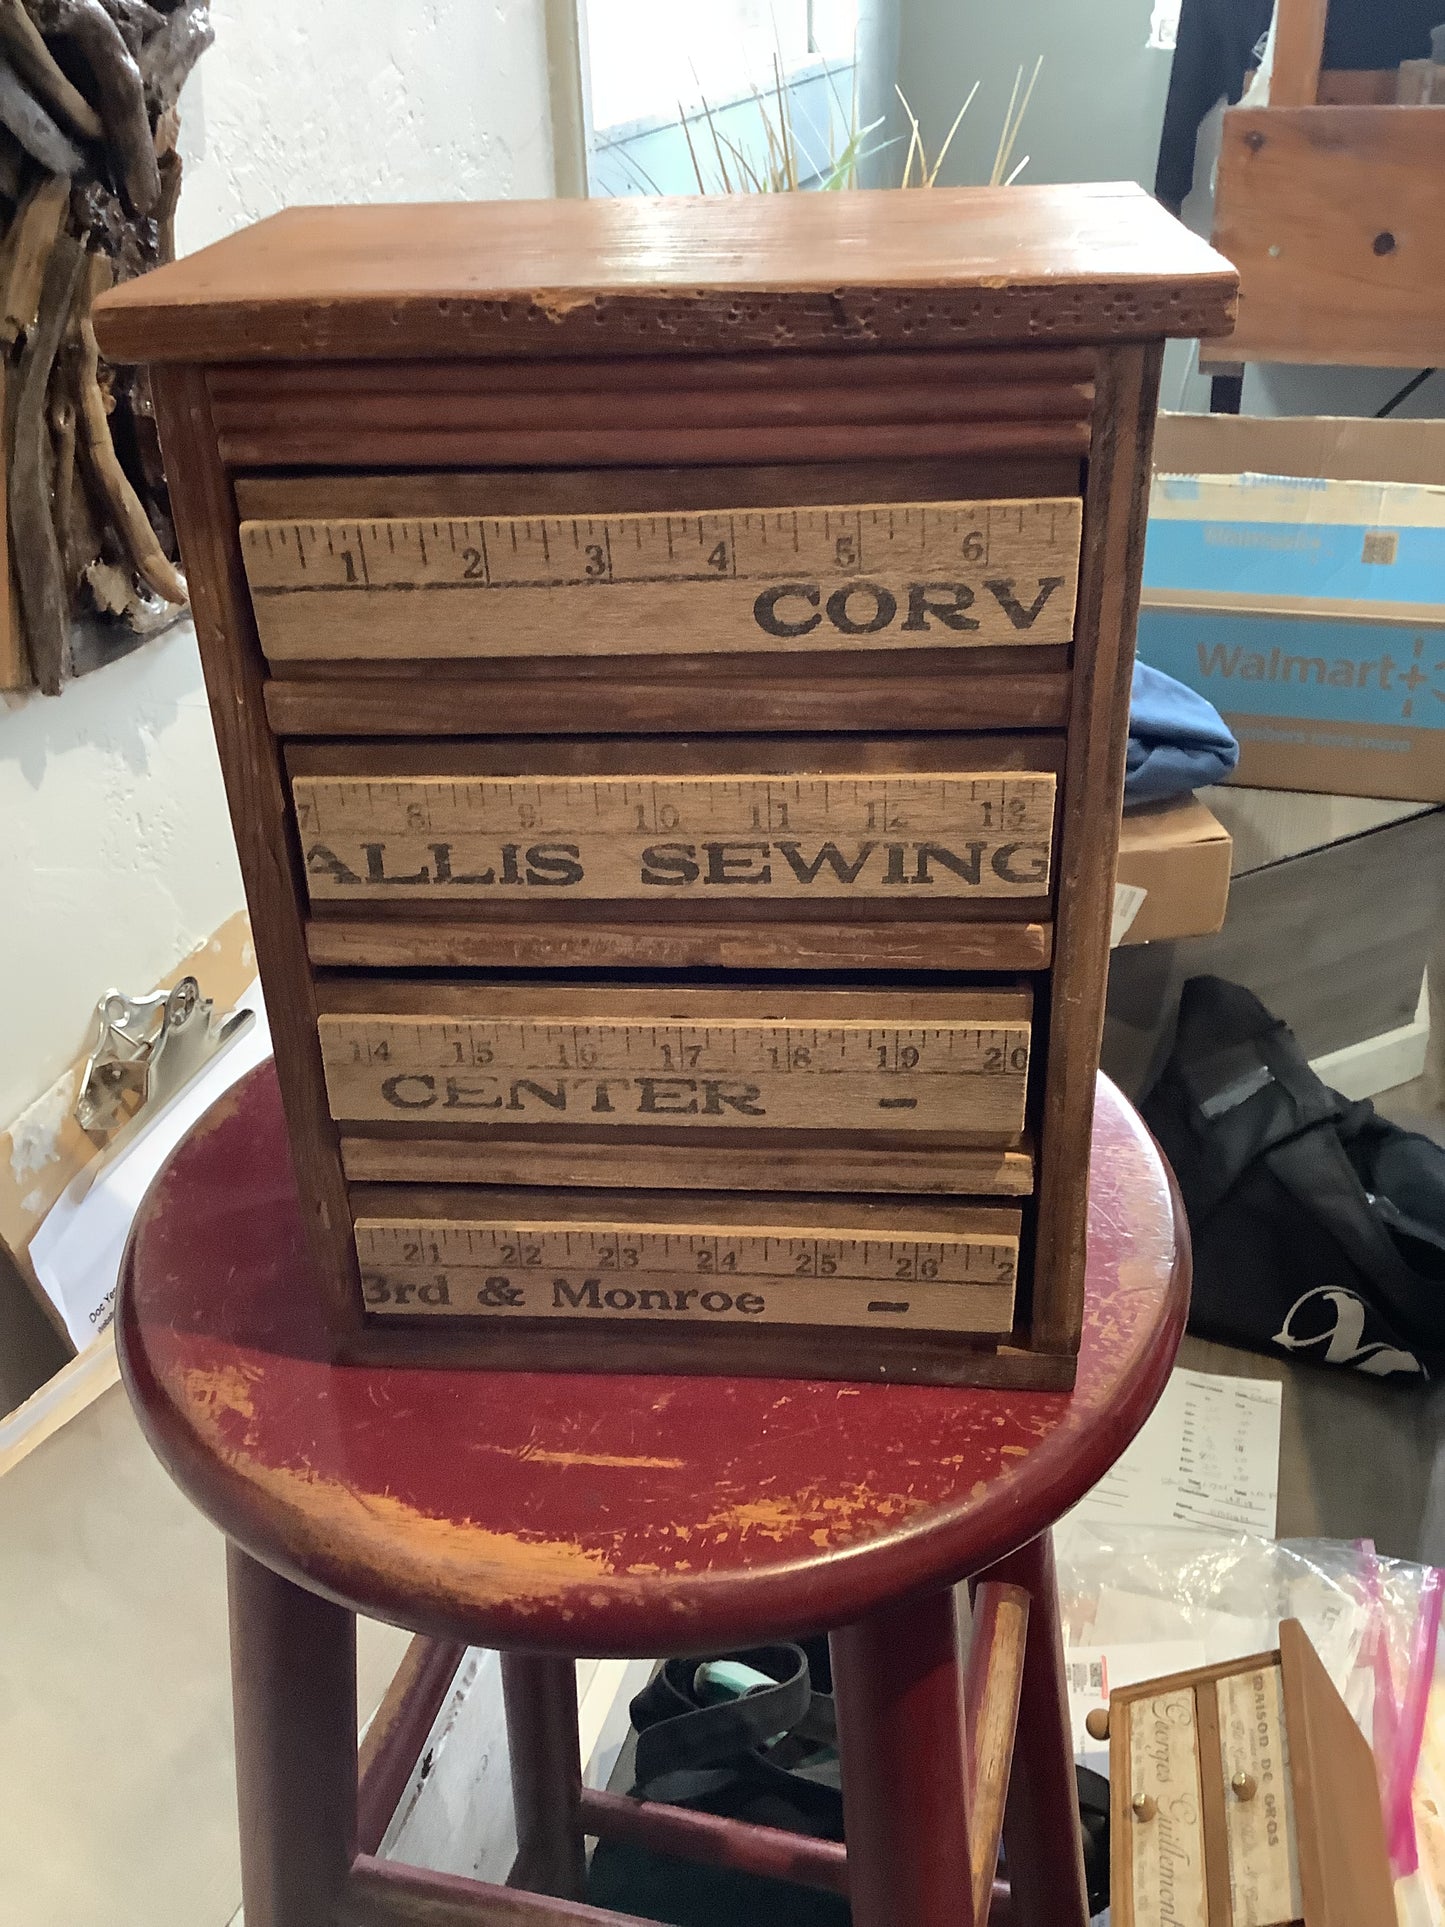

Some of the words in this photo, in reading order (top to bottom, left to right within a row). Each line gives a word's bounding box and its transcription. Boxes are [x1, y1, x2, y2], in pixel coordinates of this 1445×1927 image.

[341, 550, 358, 582] 1
[462, 547, 483, 578] 2
[584, 544, 605, 576] 3
[707, 541, 729, 572] 4
[834, 536, 855, 568] 5
[961, 531, 983, 561] 6
[753, 575, 1066, 638] CORV
[297, 804, 311, 829] 7
[634, 803, 680, 832] 10
[751, 802, 790, 832] 11
[306, 843, 584, 887] ALLIS
[641, 840, 1050, 886] SEWING
[349, 1040, 390, 1062] 14
[452, 1041, 494, 1065] 15
[660, 1044, 703, 1071] 17
[766, 1046, 812, 1070] 18
[876, 1045, 920, 1069] 19
[983, 1047, 1028, 1071] 20
[381, 1074, 766, 1116] CENTER
[403, 1243, 442, 1264] 21
[500, 1244, 542, 1265] 22
[598, 1247, 639, 1268] 23
[697, 1250, 737, 1271] 24
[795, 1253, 837, 1275] 25
[895, 1258, 938, 1279] 26
[89, 1303, 106, 1323] Doc
[362, 1271, 453, 1305] 3rd
[476, 1276, 526, 1307] &
[551, 1277, 765, 1314] Monroe
